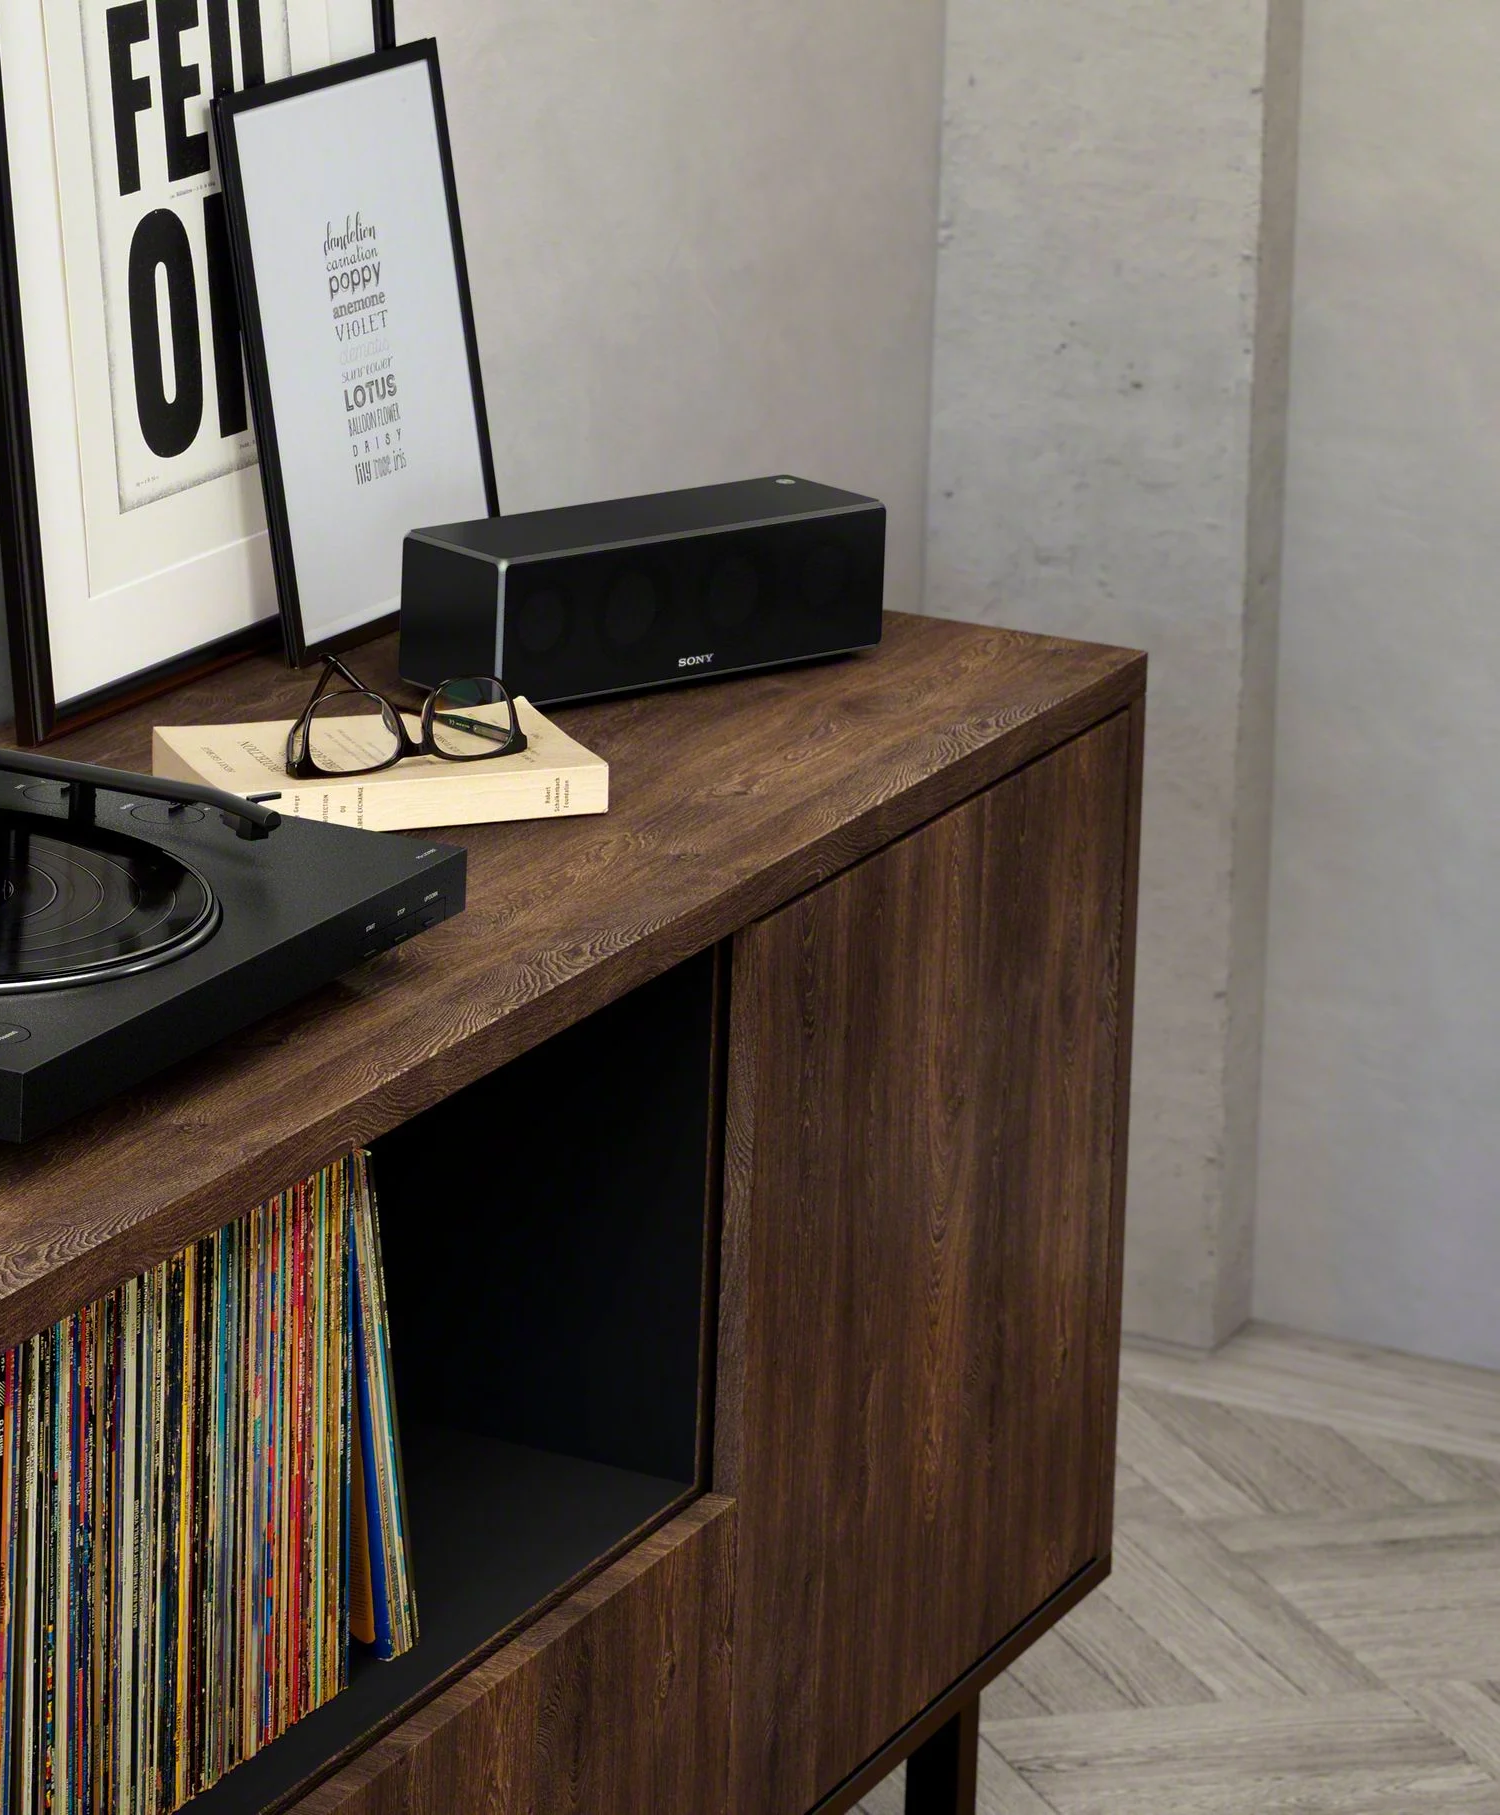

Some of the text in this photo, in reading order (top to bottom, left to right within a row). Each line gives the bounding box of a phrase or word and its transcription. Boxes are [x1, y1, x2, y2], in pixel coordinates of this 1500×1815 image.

[323, 211, 376, 256] dandelion
[326, 246, 378, 272] carnation
[329, 261, 381, 299] poppy
[332, 290, 386, 319] anemone
[335, 310, 388, 342] VIOLET
[343, 373, 398, 412] LOTUS
[347, 402, 401, 437] BALLOON FLOWER
[355, 460, 372, 485] lily
[678, 652, 715, 668] SONY
